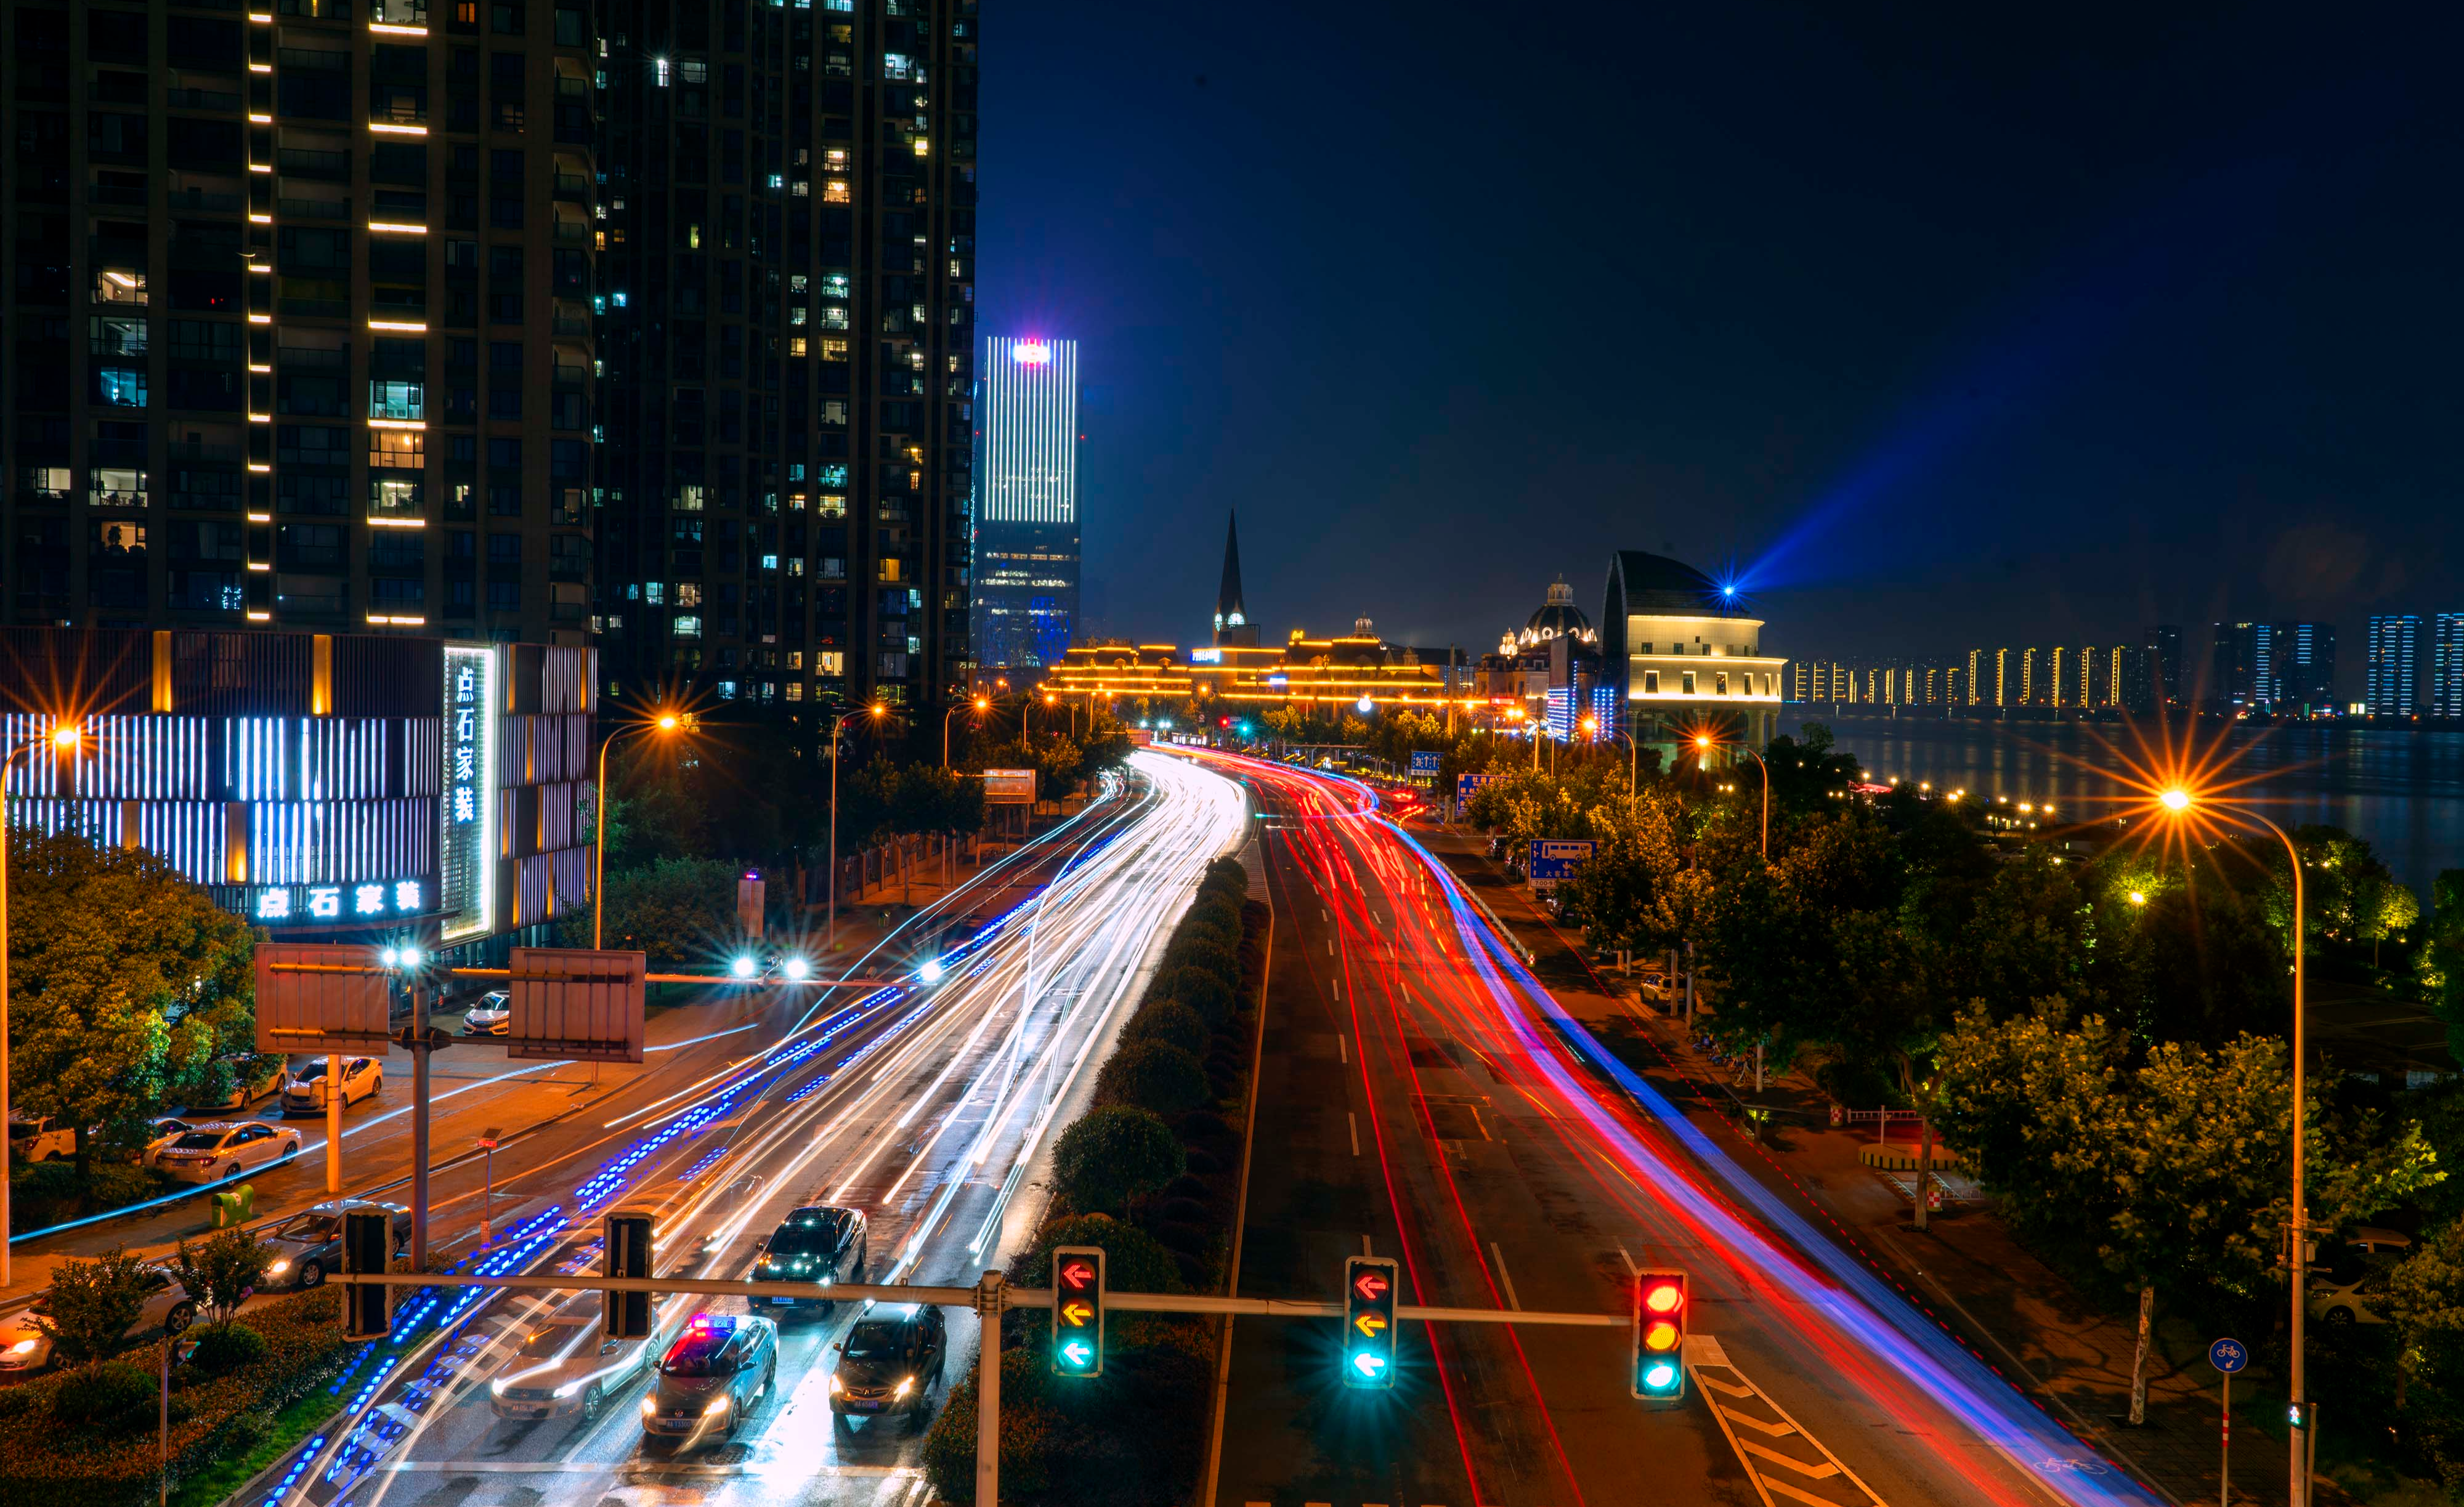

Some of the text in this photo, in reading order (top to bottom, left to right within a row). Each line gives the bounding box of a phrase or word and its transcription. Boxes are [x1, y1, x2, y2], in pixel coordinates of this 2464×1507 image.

[456, 667, 474, 822] 点石家装
[257, 881, 420, 918] 点石家装
